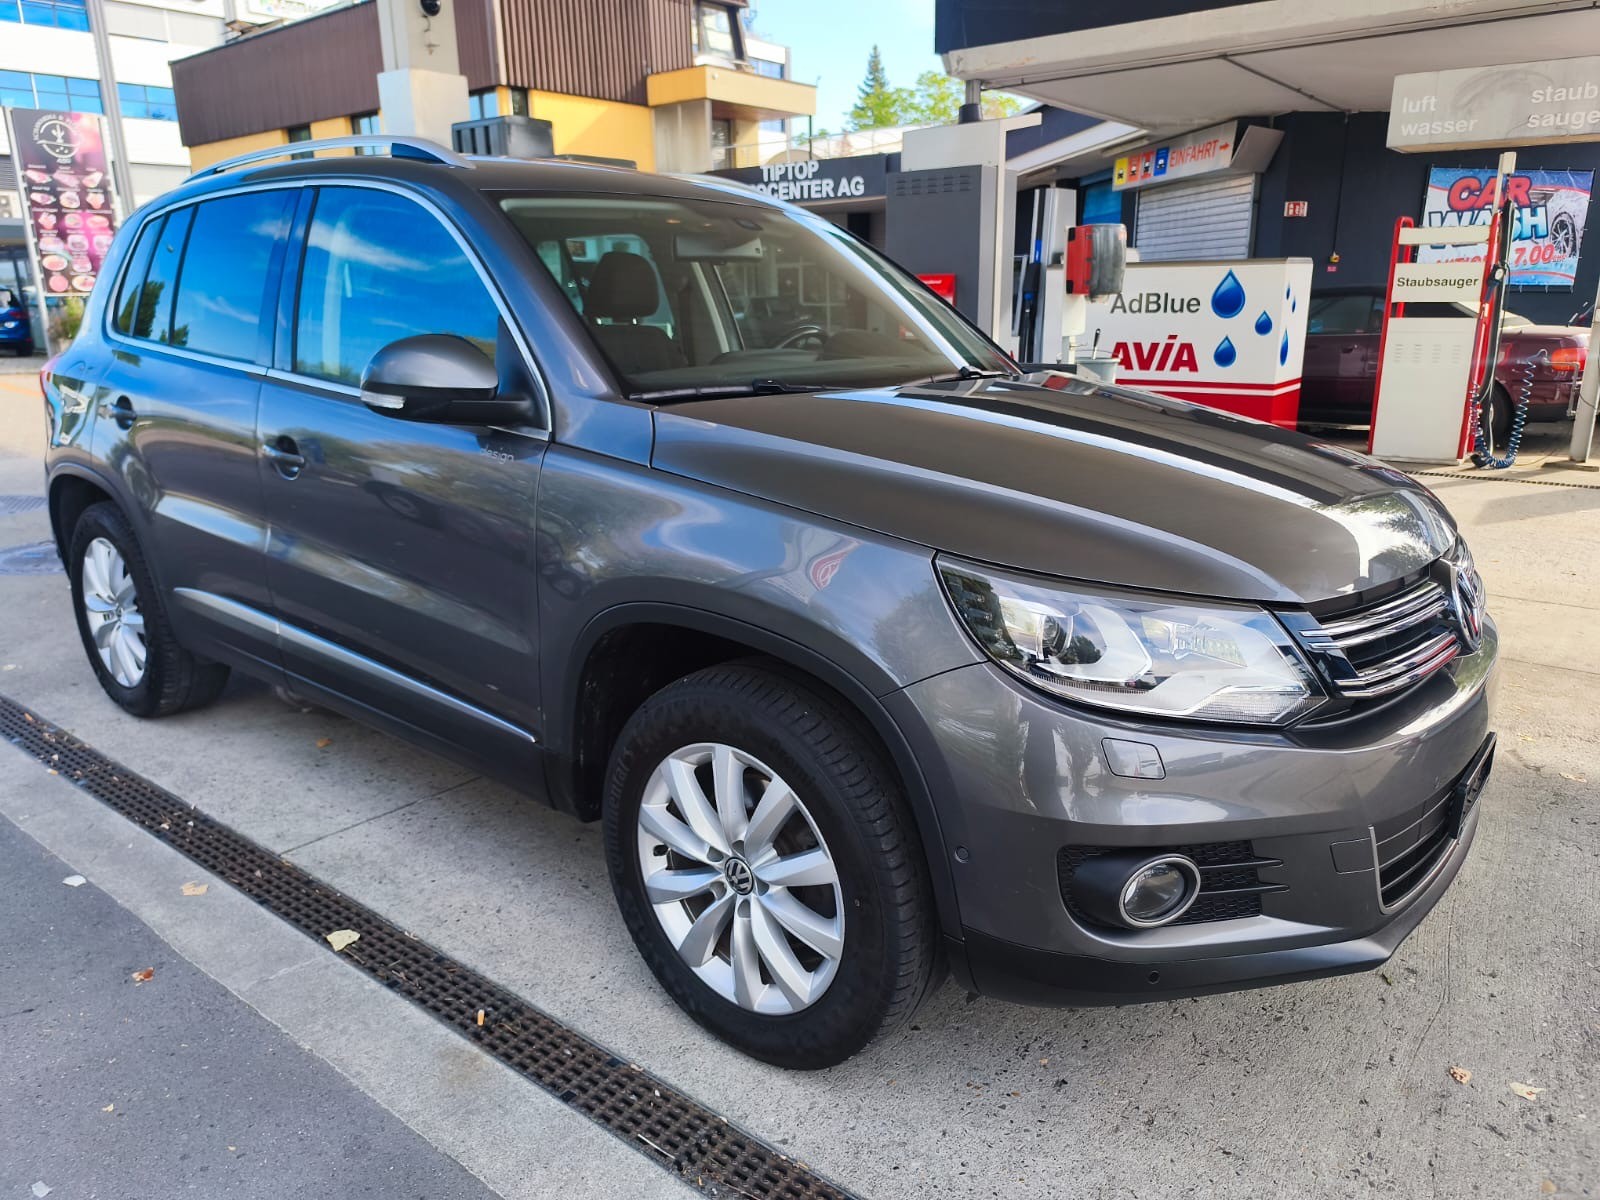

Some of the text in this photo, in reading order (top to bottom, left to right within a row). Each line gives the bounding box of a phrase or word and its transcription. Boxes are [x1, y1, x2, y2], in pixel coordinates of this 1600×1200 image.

[1402, 95, 1438, 113] luft
[1531, 82, 1598, 104] staub
[1401, 119, 1478, 136] wasser
[1169, 139, 1219, 168] EINFAHRT
[760, 160, 819, 182] TIPTOP
[750, 175, 865, 201] OCENTER AG
[1447, 176, 1532, 211] CAR
[1514, 243, 1555, 266] 7.00
[1397, 277, 1479, 289] Staubsauger
[1110, 292, 1201, 314] AdBlue
